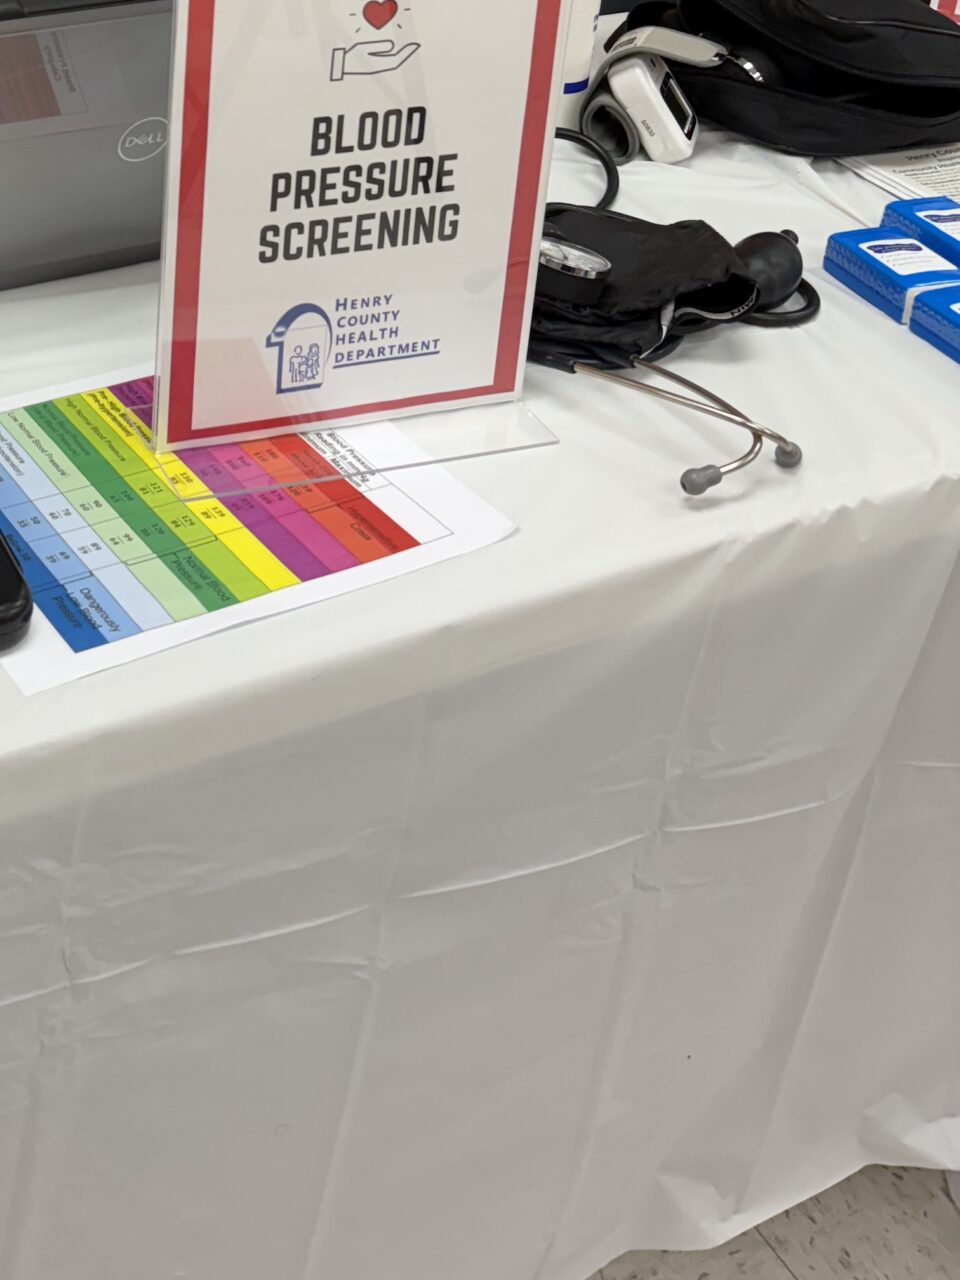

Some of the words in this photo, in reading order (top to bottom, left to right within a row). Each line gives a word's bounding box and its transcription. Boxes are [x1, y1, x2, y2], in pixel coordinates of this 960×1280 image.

[124, 131, 164, 148] DELL
[310, 106, 427, 157] BLOOD
[640, 119, 656, 138] 50830
[270, 153, 459, 212] PRESSURE
[258, 203, 461, 264] SCREENING
[334, 294, 394, 312] HENRY
[336, 310, 401, 328] COUNTY
[333, 338, 441, 363] DEPARTMENT
[334, 325, 400, 344] HEALTH
[7, 412, 19, 422] Low
[16, 421, 36, 439] Normal
[30, 438, 48, 454] Blood
[74, 408, 94, 426] Normal
[90, 425, 107, 440] Blood
[103, 439, 128, 462] Pressure
[314, 432, 340, 456] Reading
[4, 441, 26, 464] Pressure
[330, 457, 362, 487] Maxium
[170, 558, 204, 590] Pressure
[182, 554, 212, 580] Normal
[204, 579, 231, 602] Blood
[52, 595, 82, 629] Pressure
[68, 591, 82, 606] Low
[80, 606, 104, 630] Blood
[79, 587, 121, 634] Dangerously
